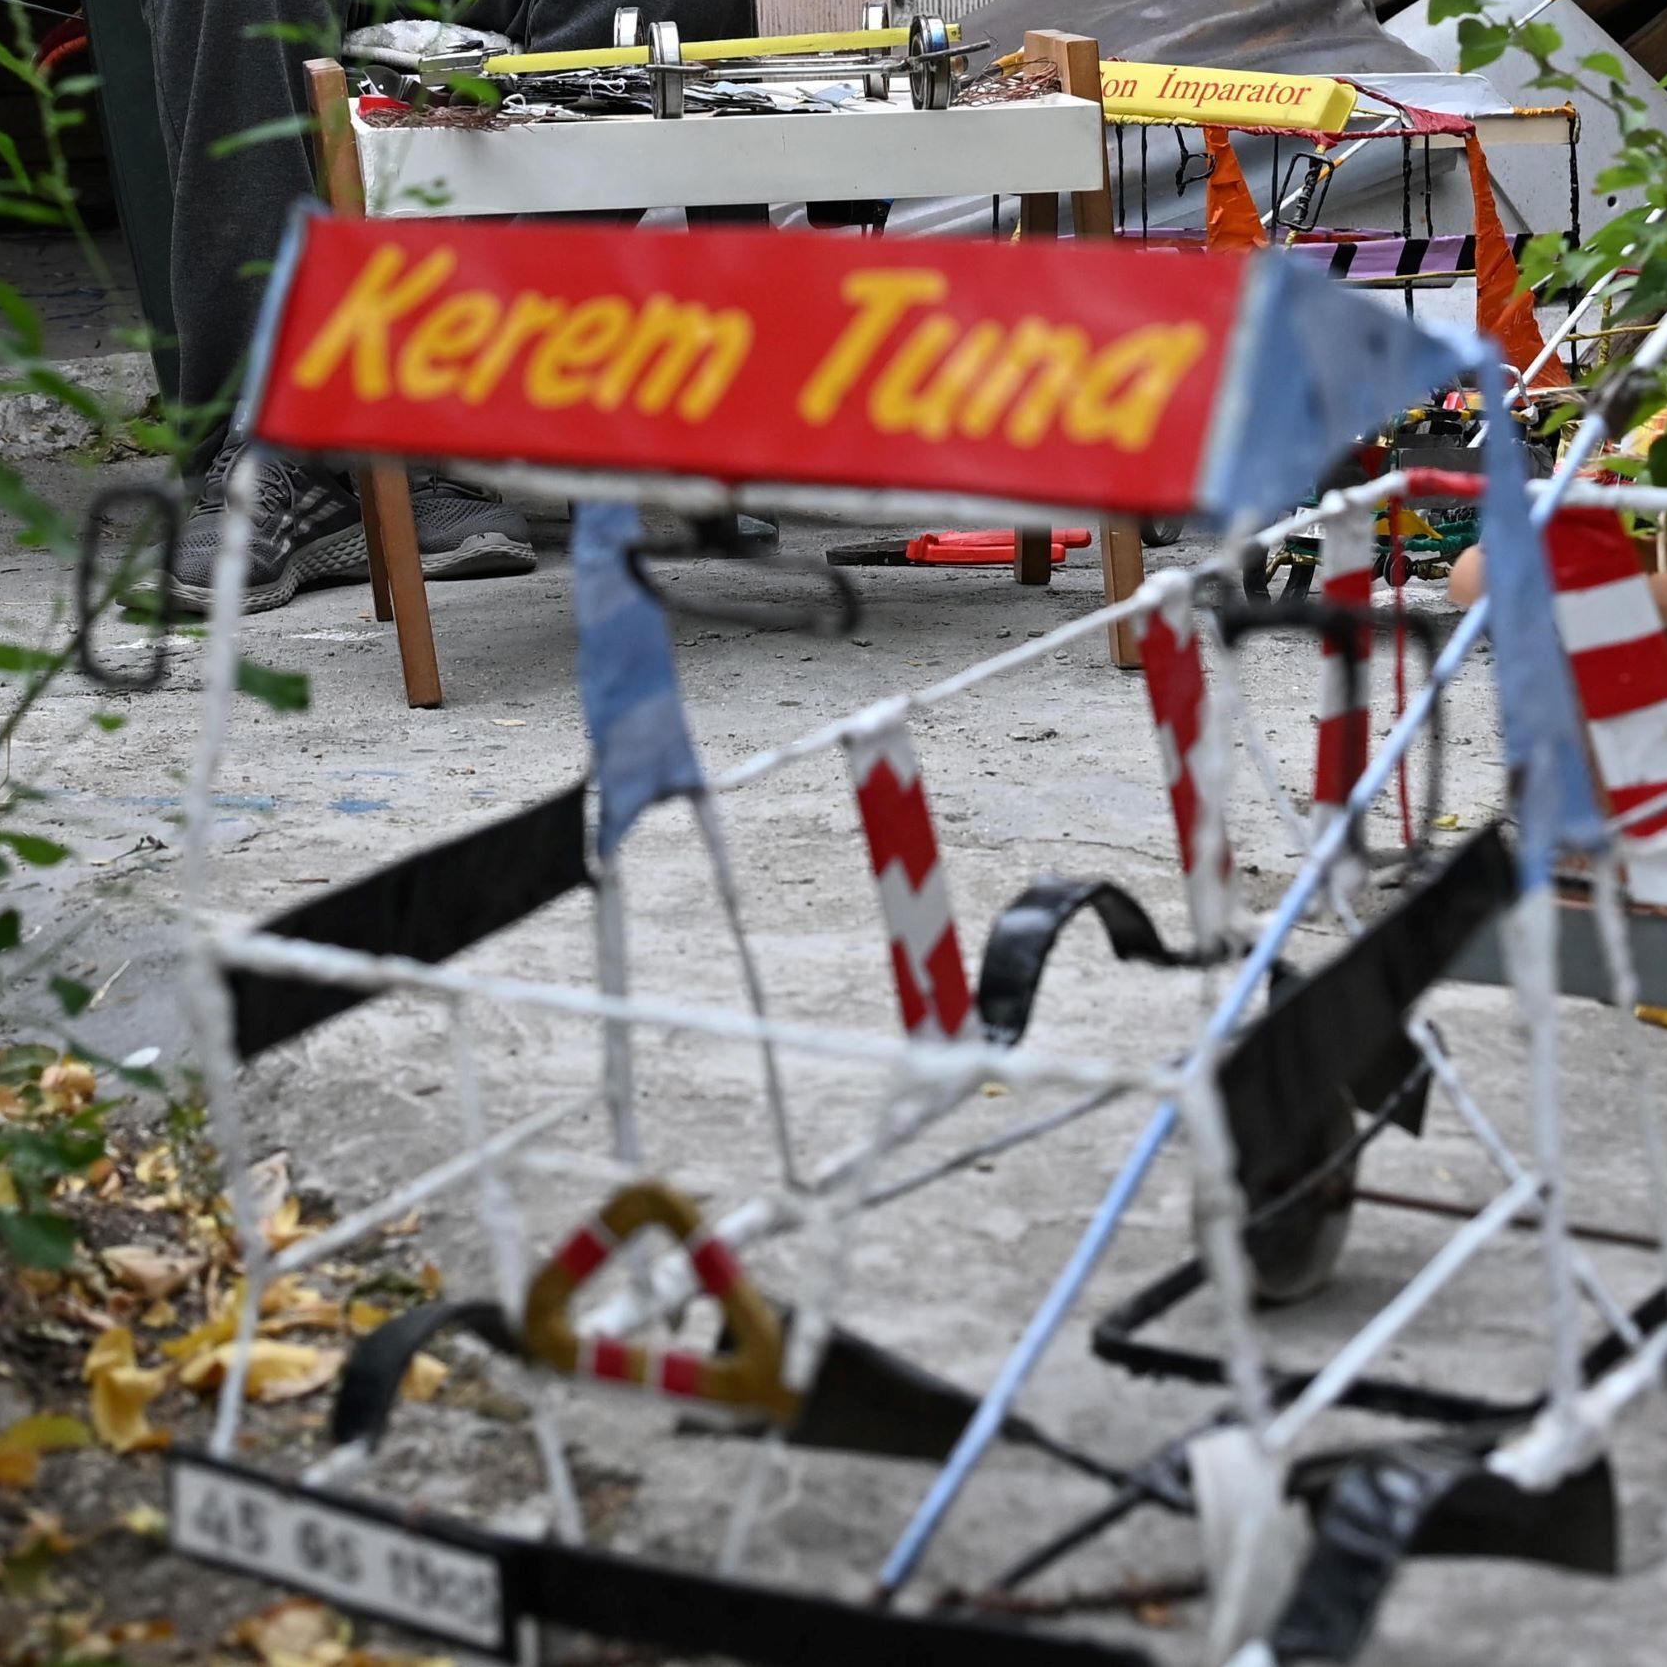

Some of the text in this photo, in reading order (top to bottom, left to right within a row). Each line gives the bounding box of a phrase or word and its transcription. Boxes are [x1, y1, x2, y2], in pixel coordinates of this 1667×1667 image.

[1099, 66, 1313, 109] on İmparator
[291, 241, 1211, 454] Kerem Tuna
